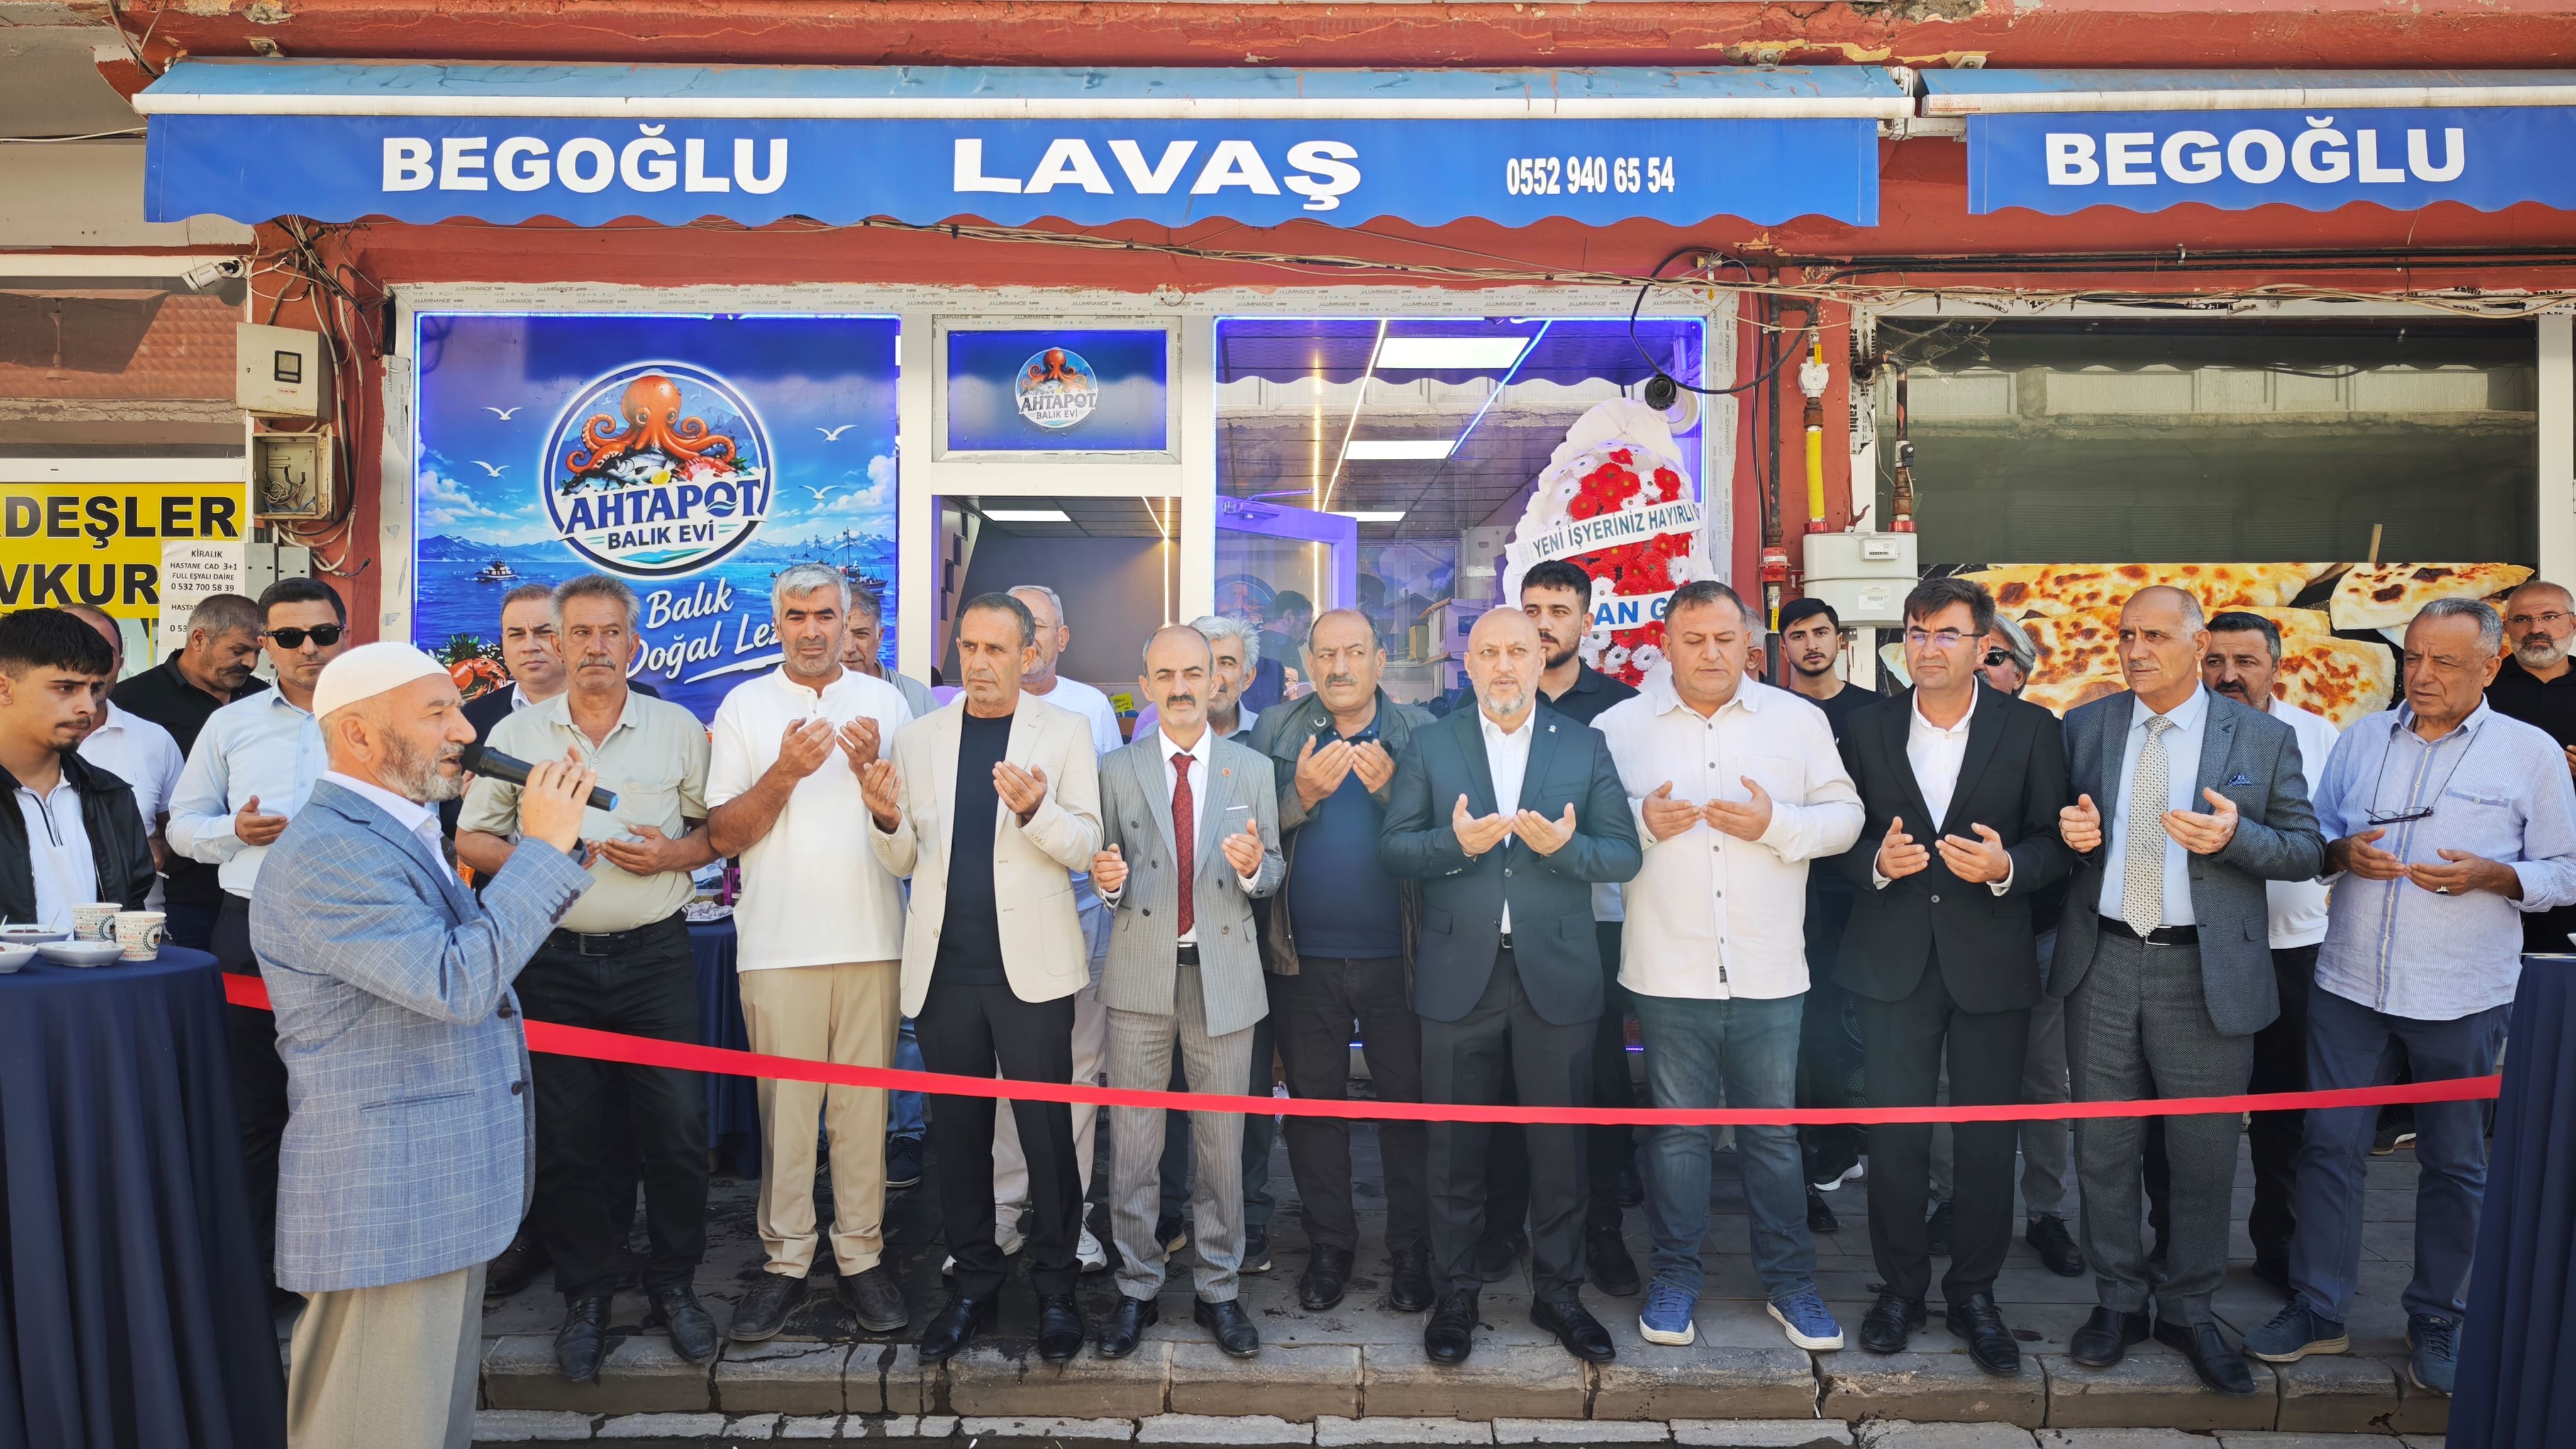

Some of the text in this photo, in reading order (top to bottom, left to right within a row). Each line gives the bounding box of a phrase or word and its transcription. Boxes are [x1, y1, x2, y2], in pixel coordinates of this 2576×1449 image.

[382, 123, 1361, 211] BEGOĞLU LAVAŞ
[2046, 116, 2465, 186] BEGOĞLU
[1507, 156, 1675, 195] 0552 940 65 54
[1021, 393, 1096, 413] AHTAPOT
[1036, 408, 1078, 419] BALIK EVİ
[564, 479, 761, 535] AHTAPOT
[191, 548, 222, 558] KİRALIK
[608, 519, 714, 550] BALIK EVİ
[1533, 527, 1564, 558] YENİ
[1568, 509, 1645, 549] İŞYERİNİZ
[190, 573, 211, 581] EŞYALI
[213, 572, 235, 580] DAİRE
[645, 577, 733, 630] Balık
